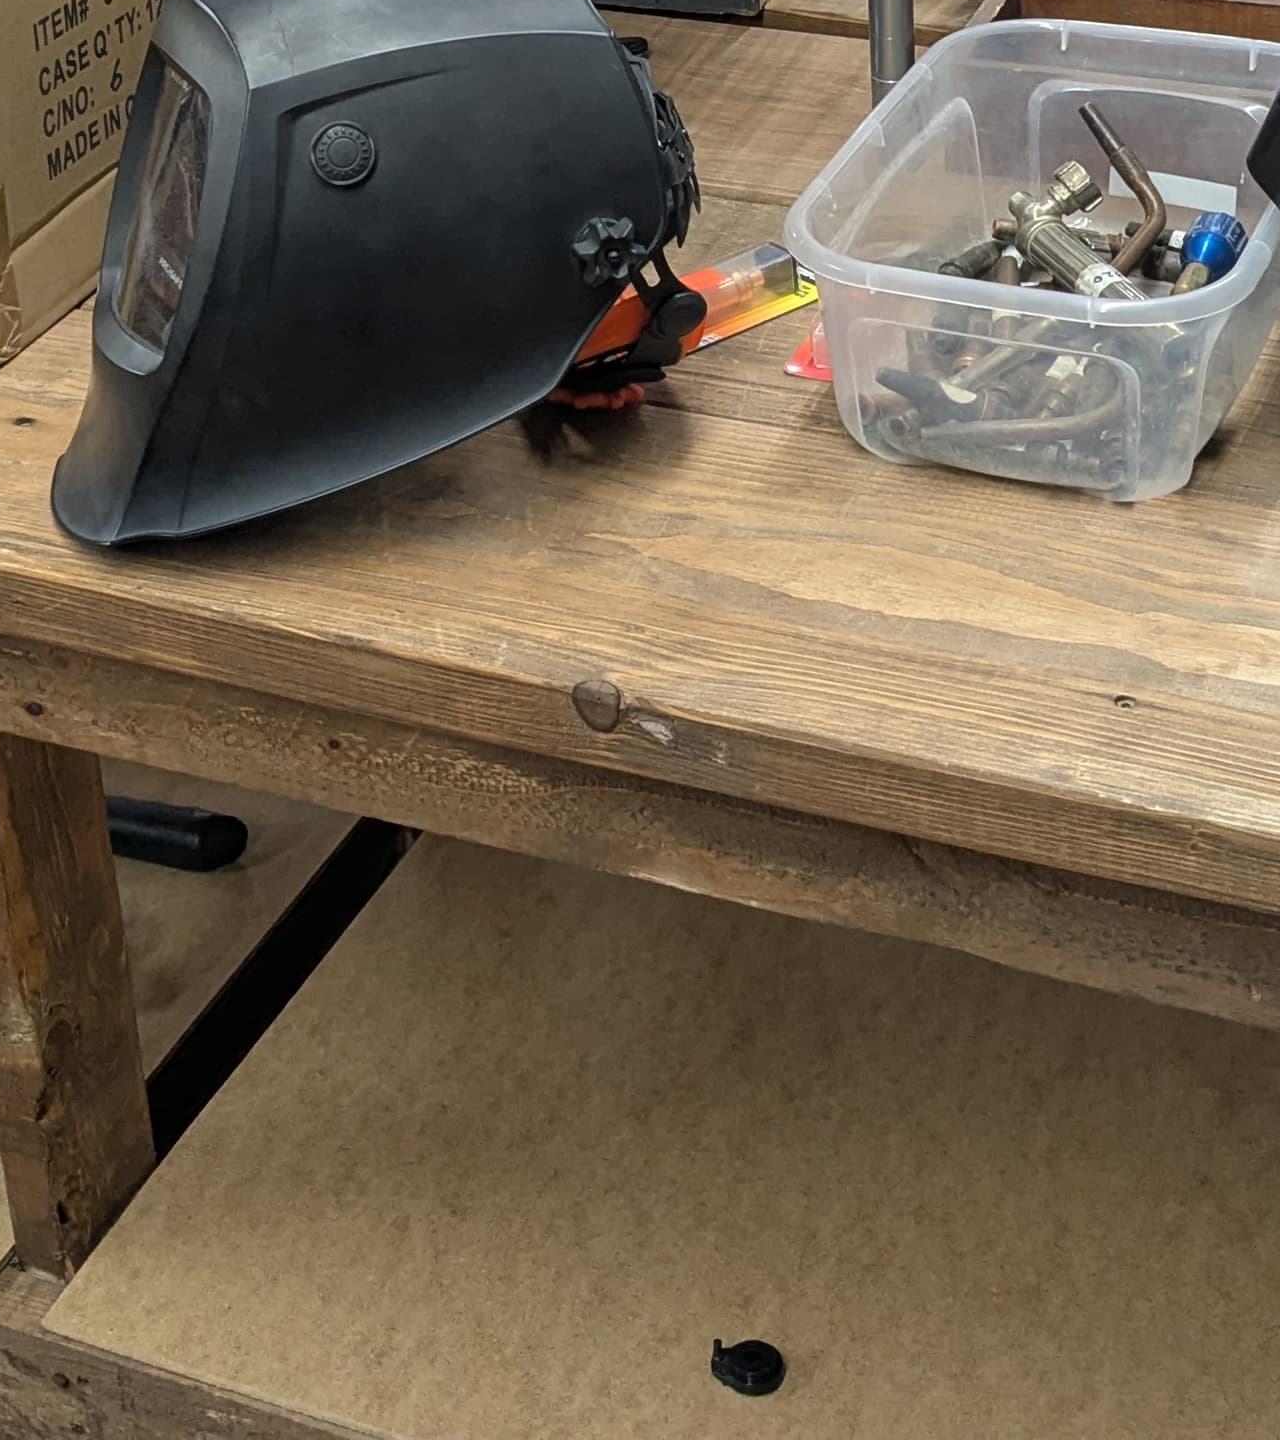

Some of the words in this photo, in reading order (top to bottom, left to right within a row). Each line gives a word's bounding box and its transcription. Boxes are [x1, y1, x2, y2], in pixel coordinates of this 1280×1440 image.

[38, 38, 91, 97] CASE
[42, 84, 96, 139] C/NO:
[110, 58, 124, 93] 6
[47, 121, 101, 182] MADE
[104, 111, 122, 141] IN
